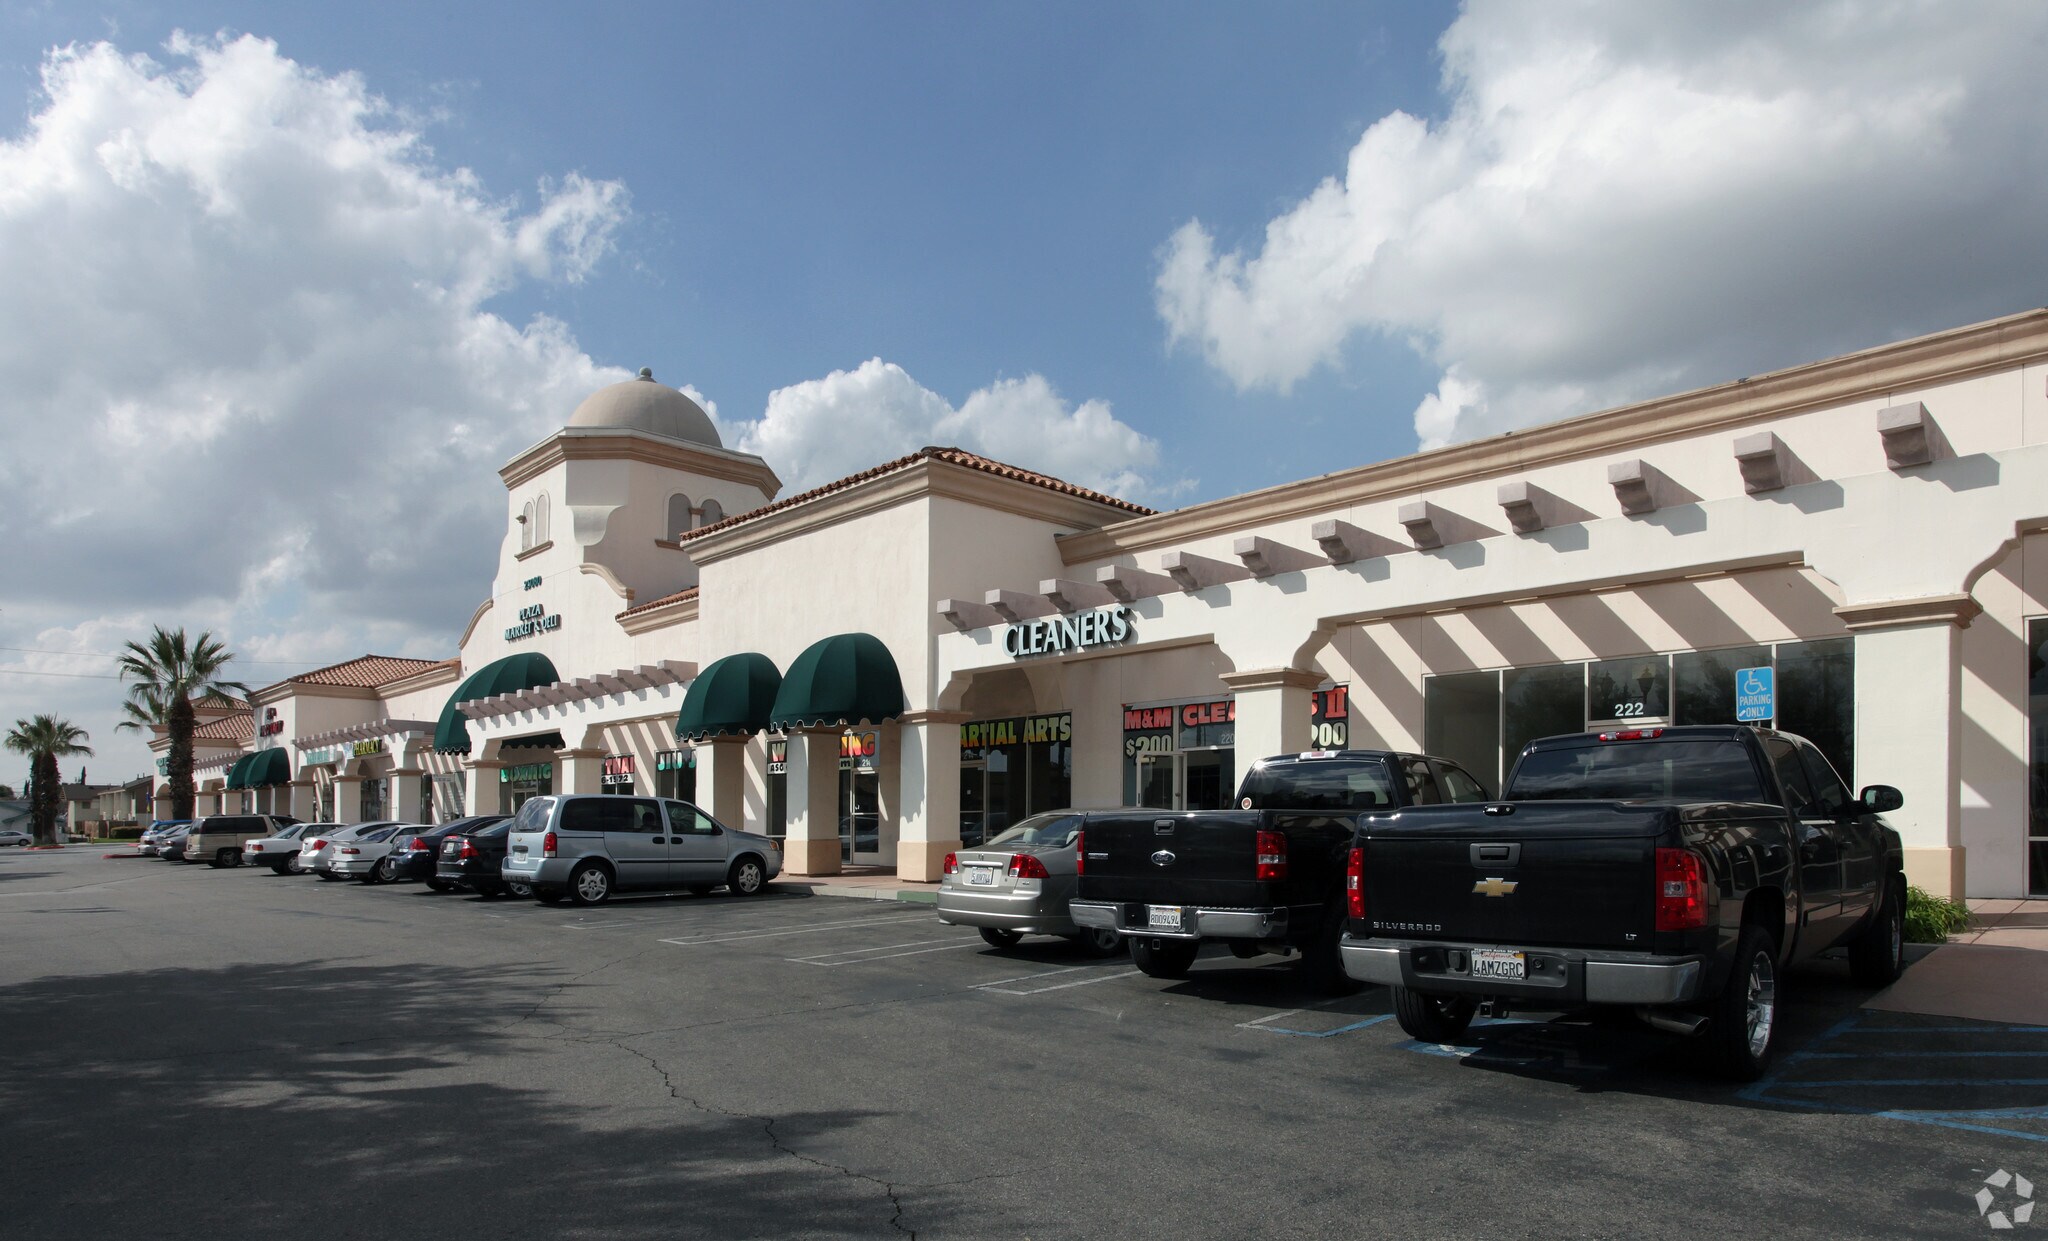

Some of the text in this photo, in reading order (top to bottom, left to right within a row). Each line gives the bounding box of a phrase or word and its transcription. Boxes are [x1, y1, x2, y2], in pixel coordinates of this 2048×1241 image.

[519, 603, 542, 620] PLAZA
[504, 620, 533, 641] MARKET
[541, 613, 559, 630] DELI
[1002, 606, 1127, 657] CLEANERS
[1740, 694, 1771, 706] PARKING
[1614, 702, 1644, 717] 222
[1745, 706, 1766, 718] ONLY
[1123, 707, 1172, 730] M&M
[960, 715, 1071, 748] ARTIAL ARTS
[657, 752, 682, 770] JIU
[1373, 921, 1441, 931] SILVERADO
[1473, 960, 1523, 977] 4AMZGRC
